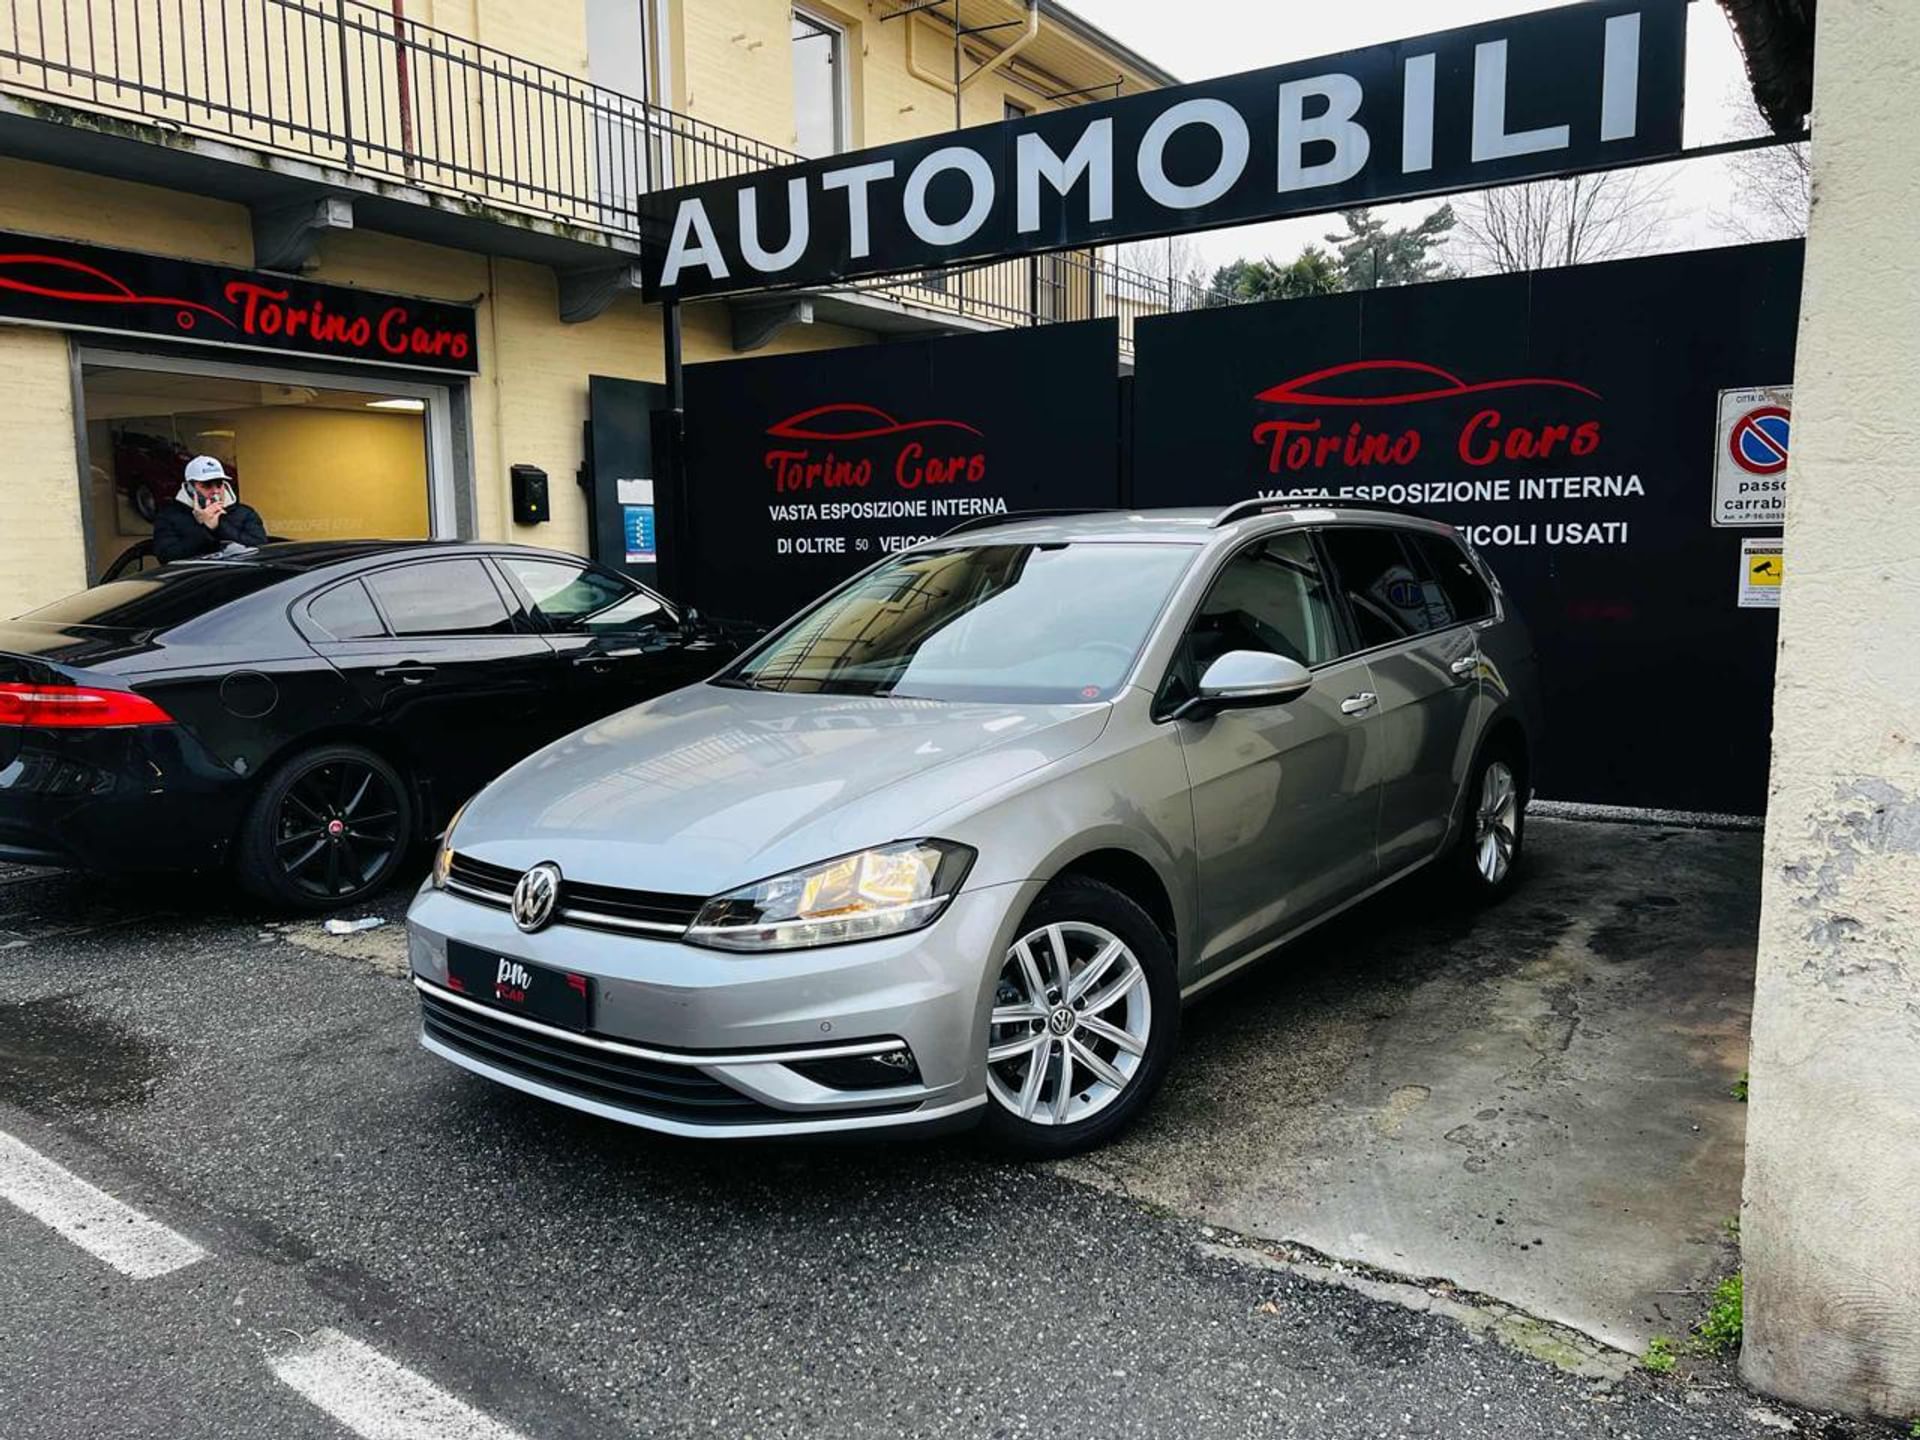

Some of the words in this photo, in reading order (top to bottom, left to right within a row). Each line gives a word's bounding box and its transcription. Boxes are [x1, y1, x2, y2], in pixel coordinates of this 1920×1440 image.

[659, 11, 1642, 287] AUTOMOBILI
[224, 281, 371, 347] Torino
[377, 308, 469, 359] Cars
[1253, 420, 1421, 472] Torino
[1459, 410, 1600, 465] Cars
[766, 451, 872, 493] Torino
[895, 444, 984, 489] Cars
[769, 504, 818, 521] VASTA
[820, 500, 927, 520] ESPOSIZIONE
[931, 497, 1008, 517] INTERNA
[1340, 480, 1510, 506] ESPOSIZIONE
[1519, 474, 1645, 500] INTERNA
[777, 538, 792, 554] DI
[795, 537, 846, 554] OLTRE
[855, 538, 869, 551] 50
[879, 536, 949, 554] VEIC
[1546, 522, 1628, 545] USATI
